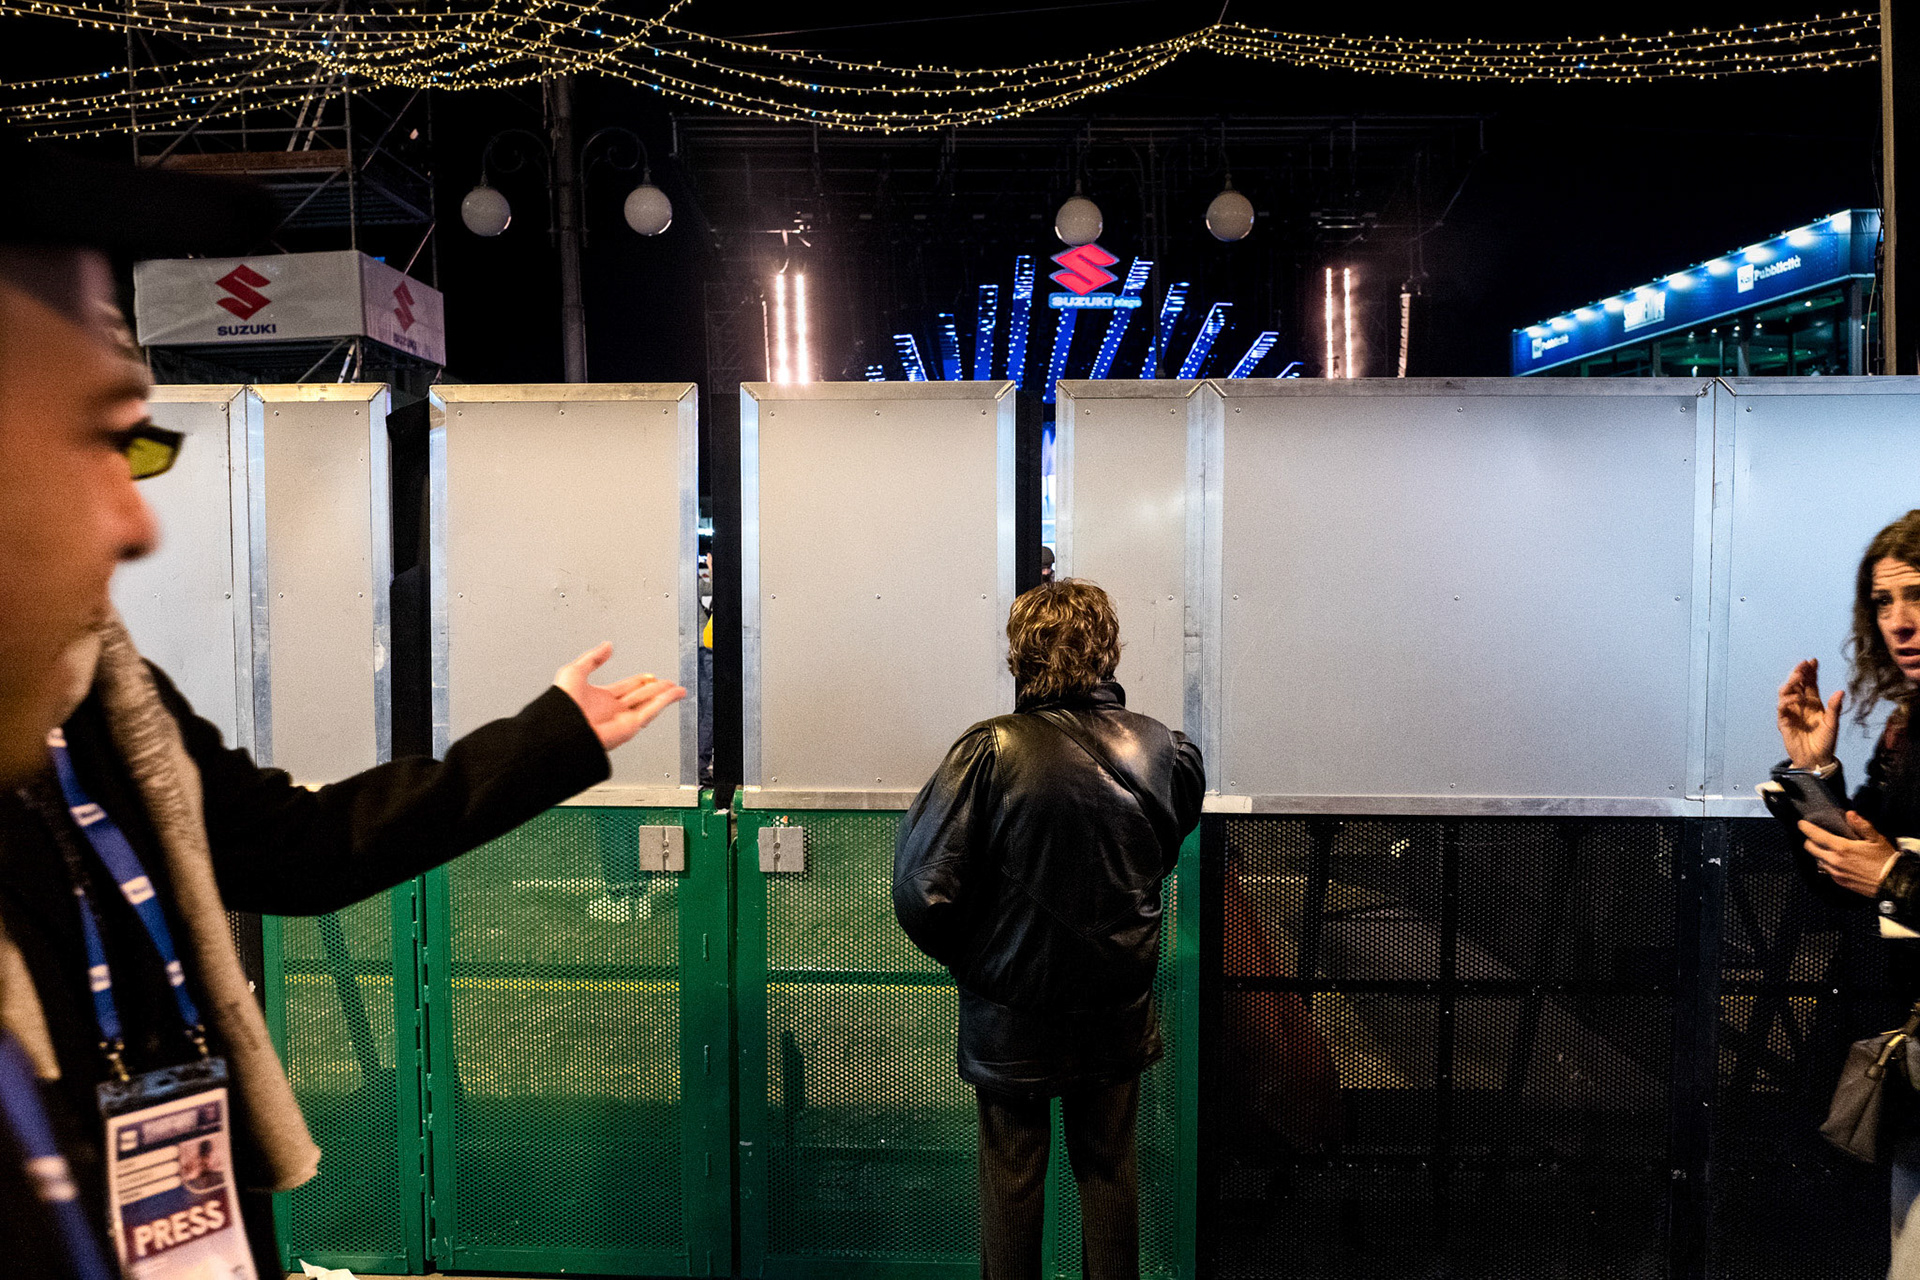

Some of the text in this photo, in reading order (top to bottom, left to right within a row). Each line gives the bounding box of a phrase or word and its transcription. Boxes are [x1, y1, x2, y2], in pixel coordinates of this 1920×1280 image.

[1051, 296, 1113, 307] SUZUKI
[217, 323, 277, 337] SUZUKI
[133, 1199, 226, 1257] PRESS
